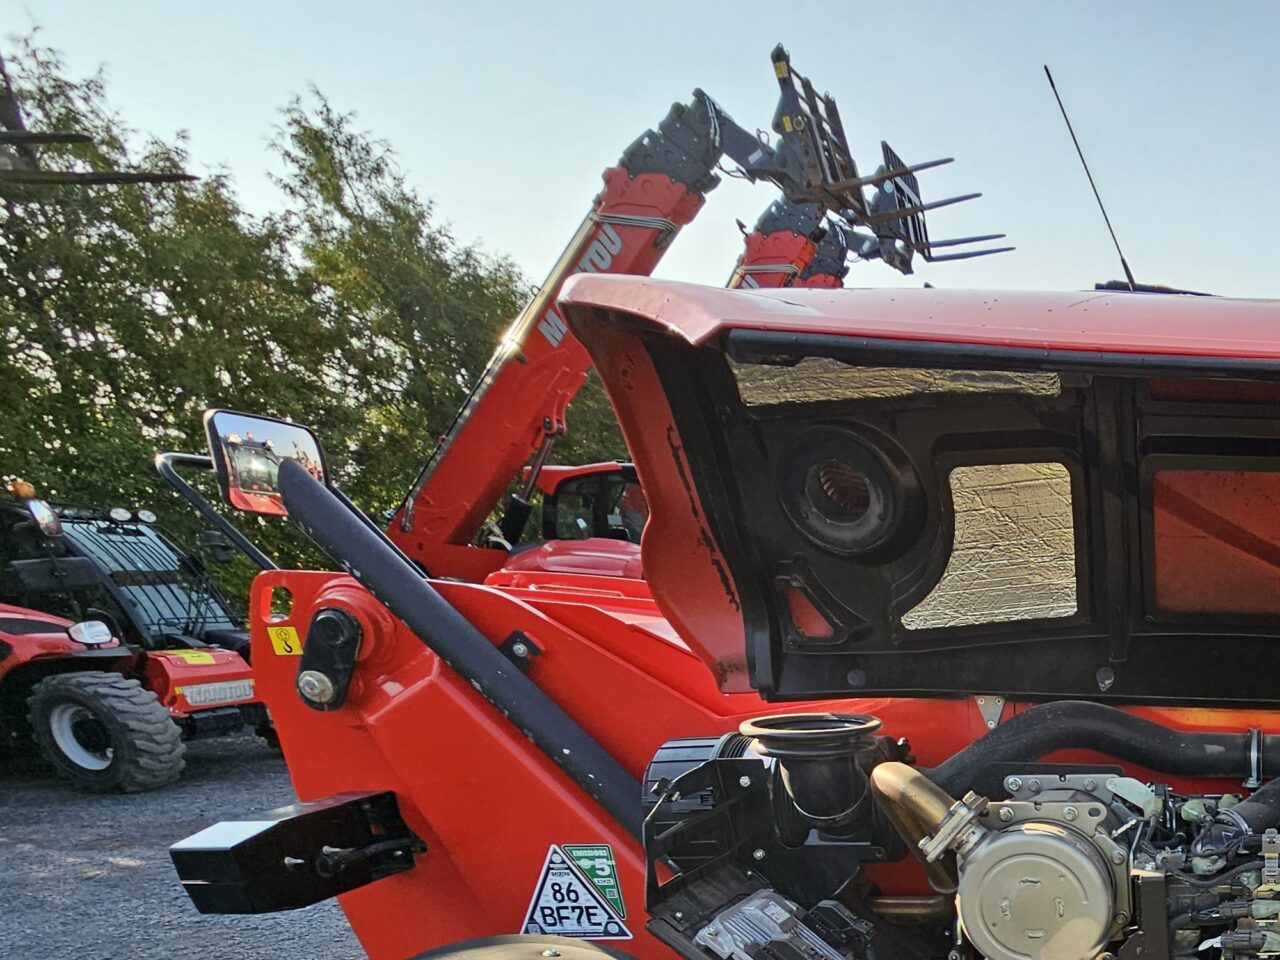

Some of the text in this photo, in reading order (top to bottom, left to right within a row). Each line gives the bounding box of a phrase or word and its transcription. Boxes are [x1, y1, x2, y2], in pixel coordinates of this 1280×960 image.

[595, 859, 610, 875] 5
[551, 882, 579, 903] 86
[540, 906, 602, 927] BF7E
